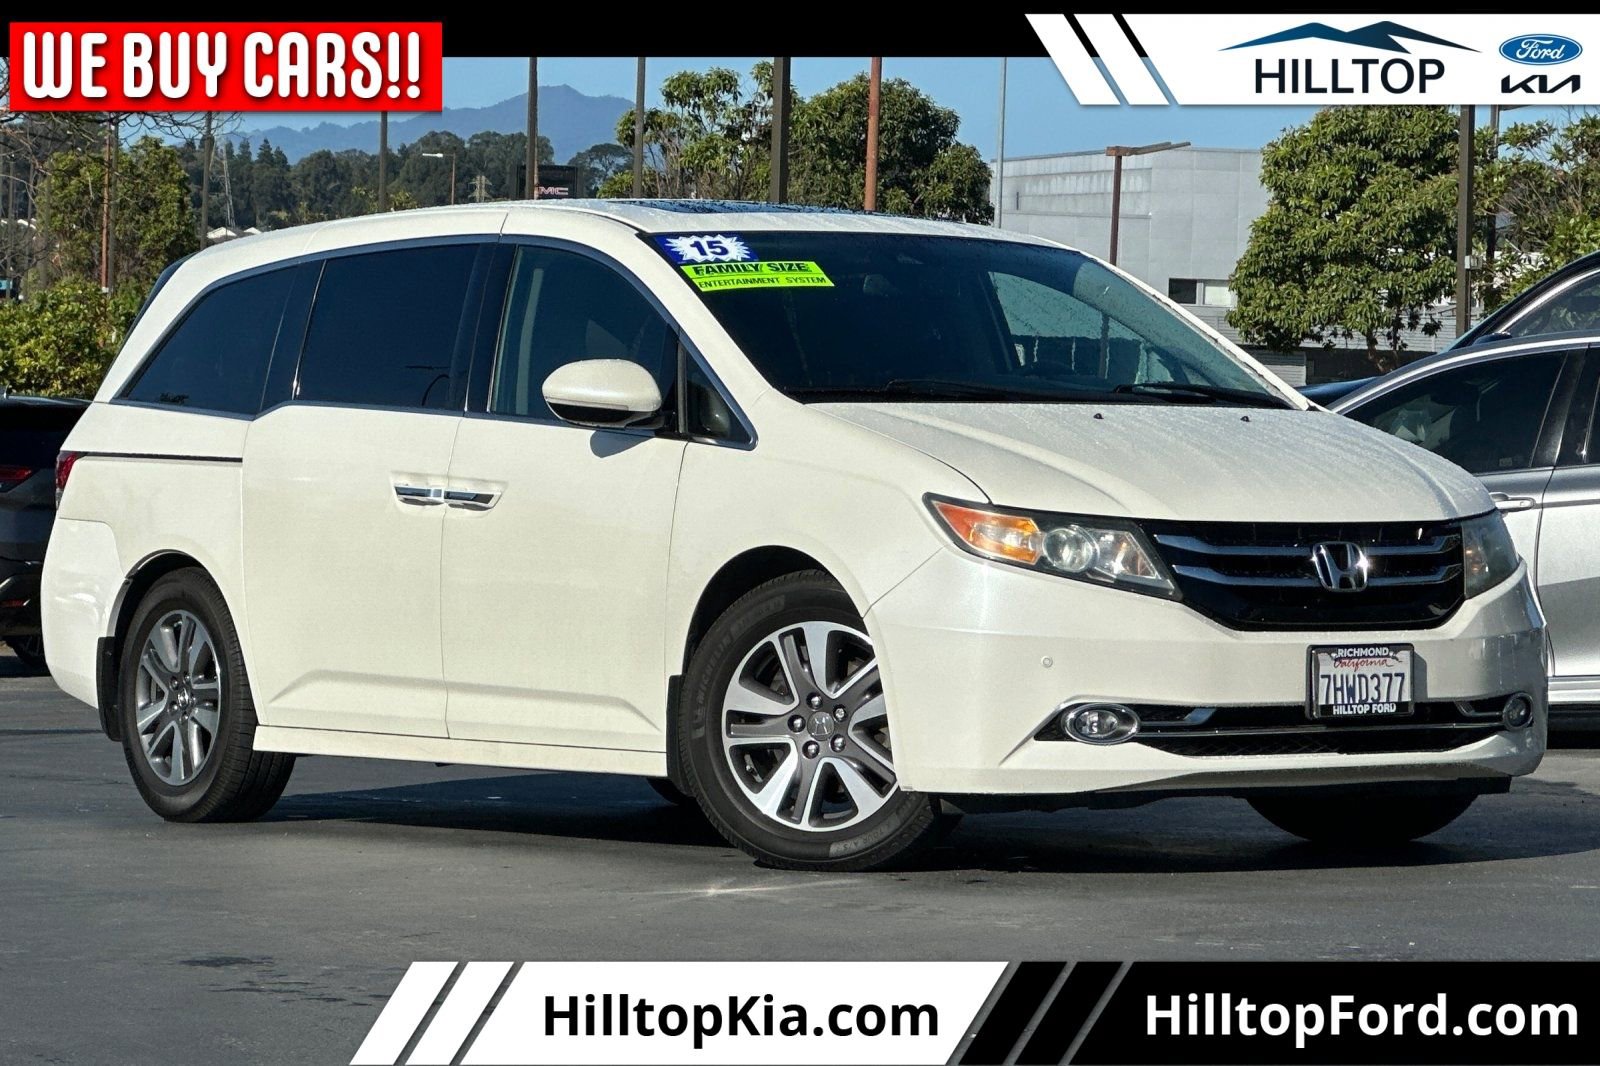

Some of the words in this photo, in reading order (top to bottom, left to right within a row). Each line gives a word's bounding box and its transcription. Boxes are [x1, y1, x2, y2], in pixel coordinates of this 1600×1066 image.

[538, 186, 569, 196] MC
[689, 240, 729, 257] 15
[693, 263, 763, 277] FAMILY
[769, 262, 812, 273] SIZE
[699, 277, 781, 289] ENTERTAINMENT
[786, 276, 827, 284] SYSTEM
[1336, 646, 1389, 658] RICHMOND
[1333, 658, 1394, 673] California
[1320, 672, 1406, 705] 7HWD377
[1332, 703, 1370, 715] HILLTOP
[1371, 702, 1397, 714] FORD
